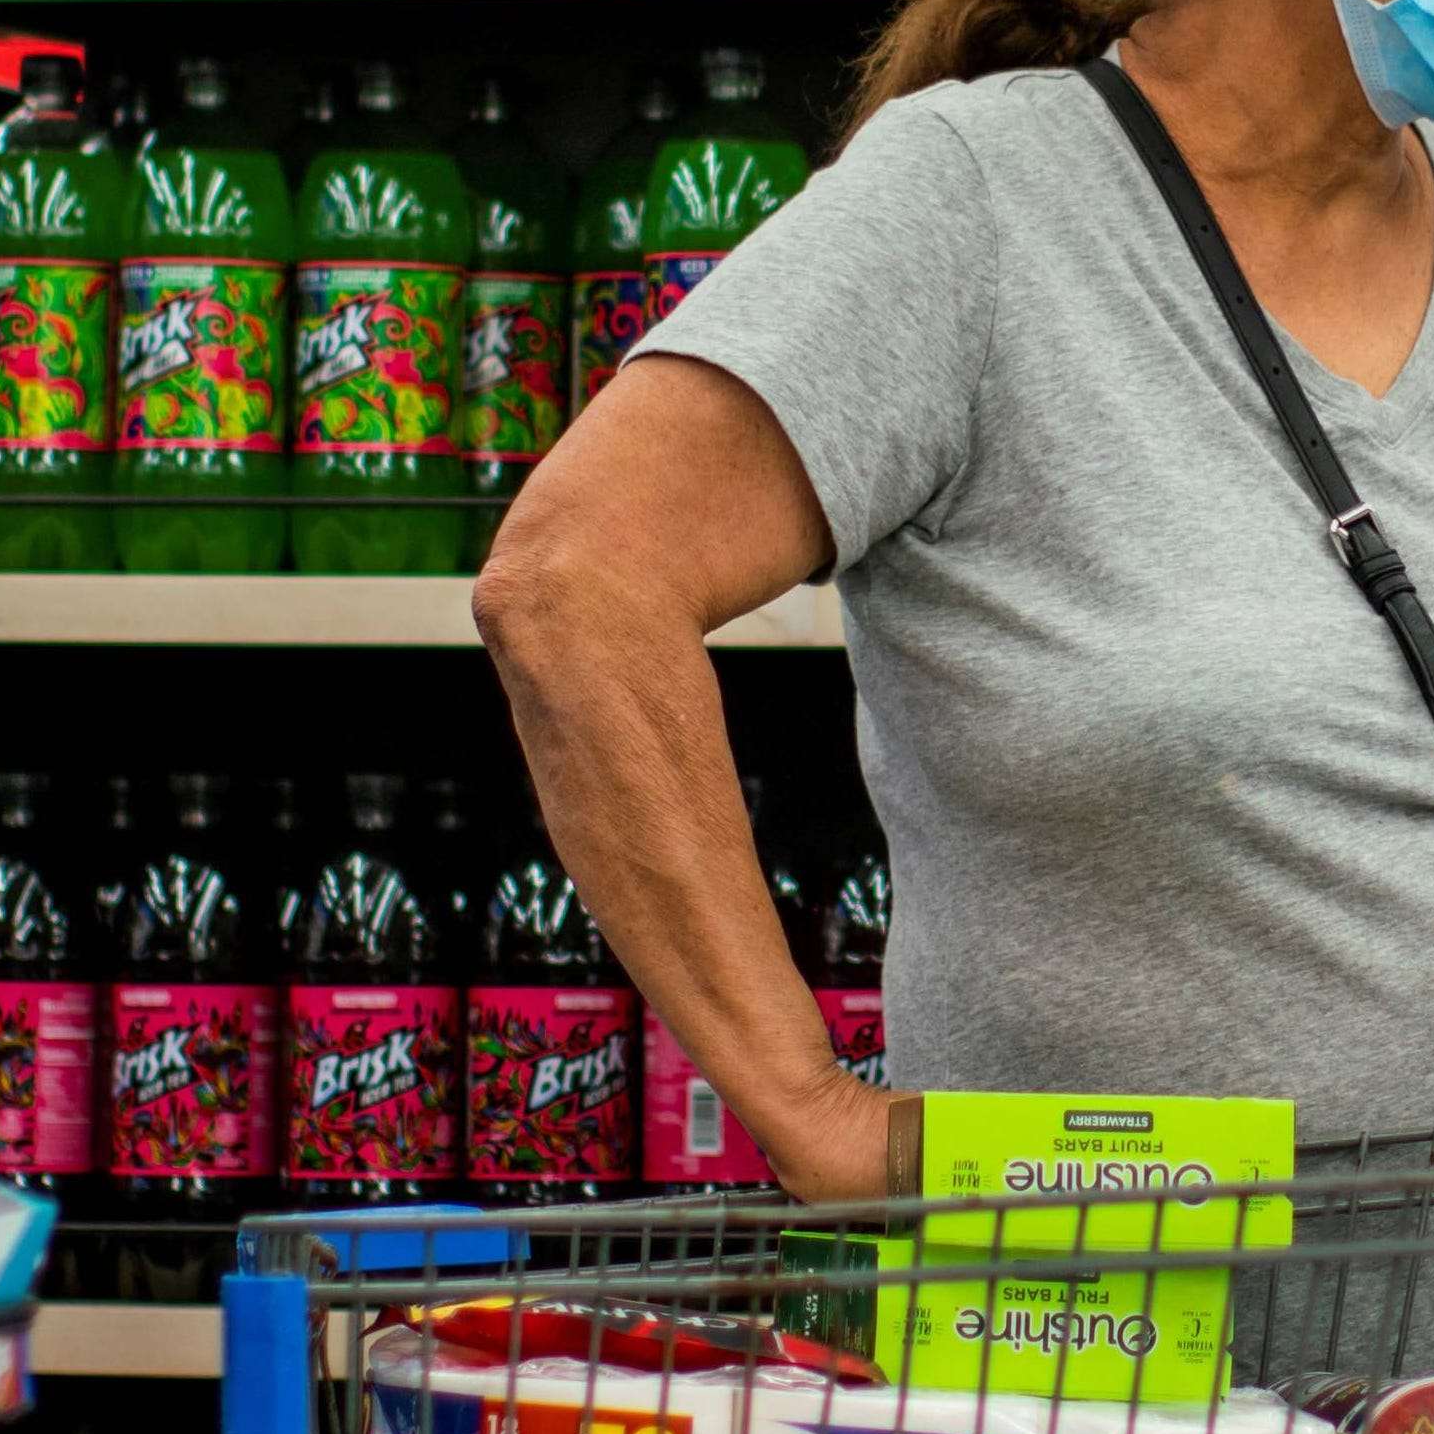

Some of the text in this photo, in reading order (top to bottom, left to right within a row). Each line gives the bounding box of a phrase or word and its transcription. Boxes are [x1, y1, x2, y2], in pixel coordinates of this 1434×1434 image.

[1068, 1114, 1150, 1129] STRAWBERRY
[1053, 1138, 1164, 1154] FRUIT BARS
[1003, 1287, 1051, 1302] BARS
